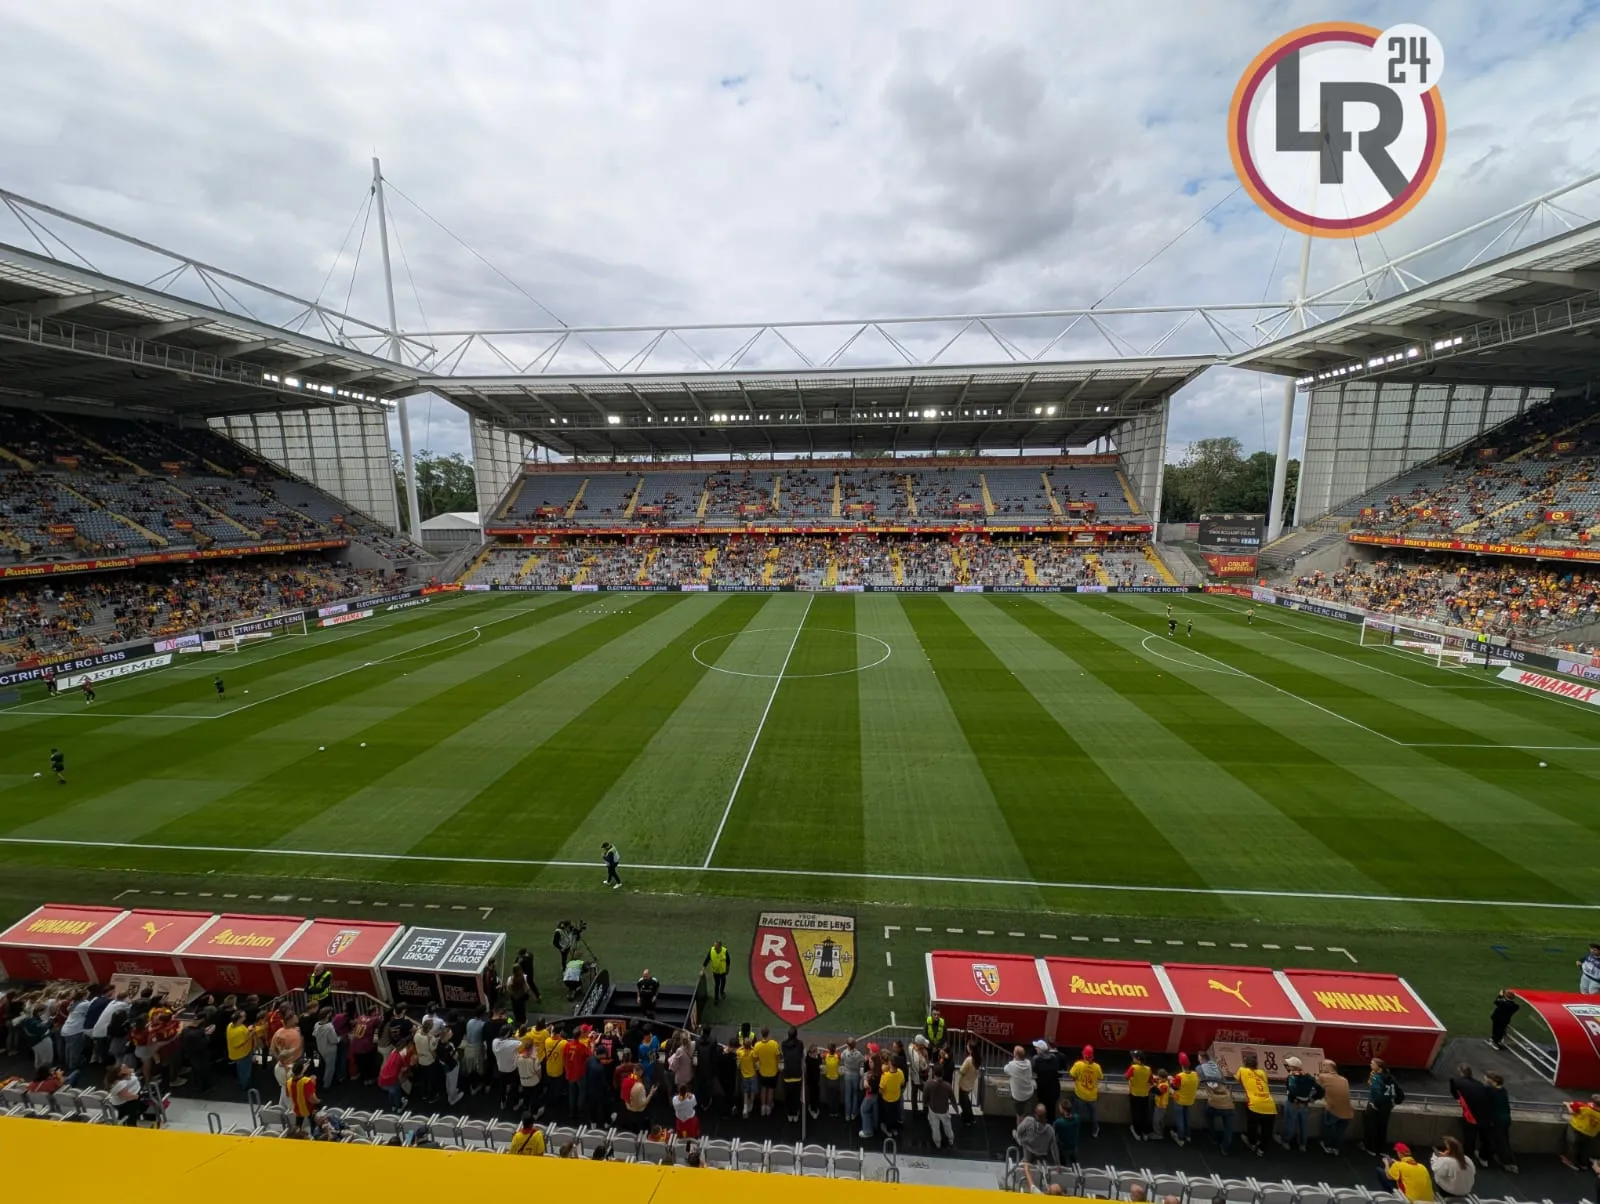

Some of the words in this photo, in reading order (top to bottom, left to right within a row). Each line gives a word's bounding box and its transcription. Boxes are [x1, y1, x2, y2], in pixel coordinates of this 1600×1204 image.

[1467, 543, 1484, 551] Krys
[1489, 544, 1506, 553] Krys
[1510, 545, 1529, 554] Krys
[53, 563, 89, 573] Auchan
[95, 560, 128, 569] Auchan
[4, 567, 45, 577] Auchan
[1465, 641, 1477, 650] LE
[1496, 647, 1525, 661] LENS
[57, 662, 72, 673] LE
[75, 657, 93, 669] RC
[95, 651, 126, 664] LENS
[1519, 671, 1599, 701] WINAMAX
[762, 917, 793, 927] RACING
[795, 919, 816, 928] CLUB
[817, 920, 829, 929] DE
[830, 920, 852, 930] LENS
[208, 928, 276, 948] Auchan
[401, 951, 436, 962] LENSOIS
[448, 954, 482, 964] LENSOIS
[1069, 975, 1149, 998] Auchan
[1313, 991, 1410, 1013] WINAMAX
